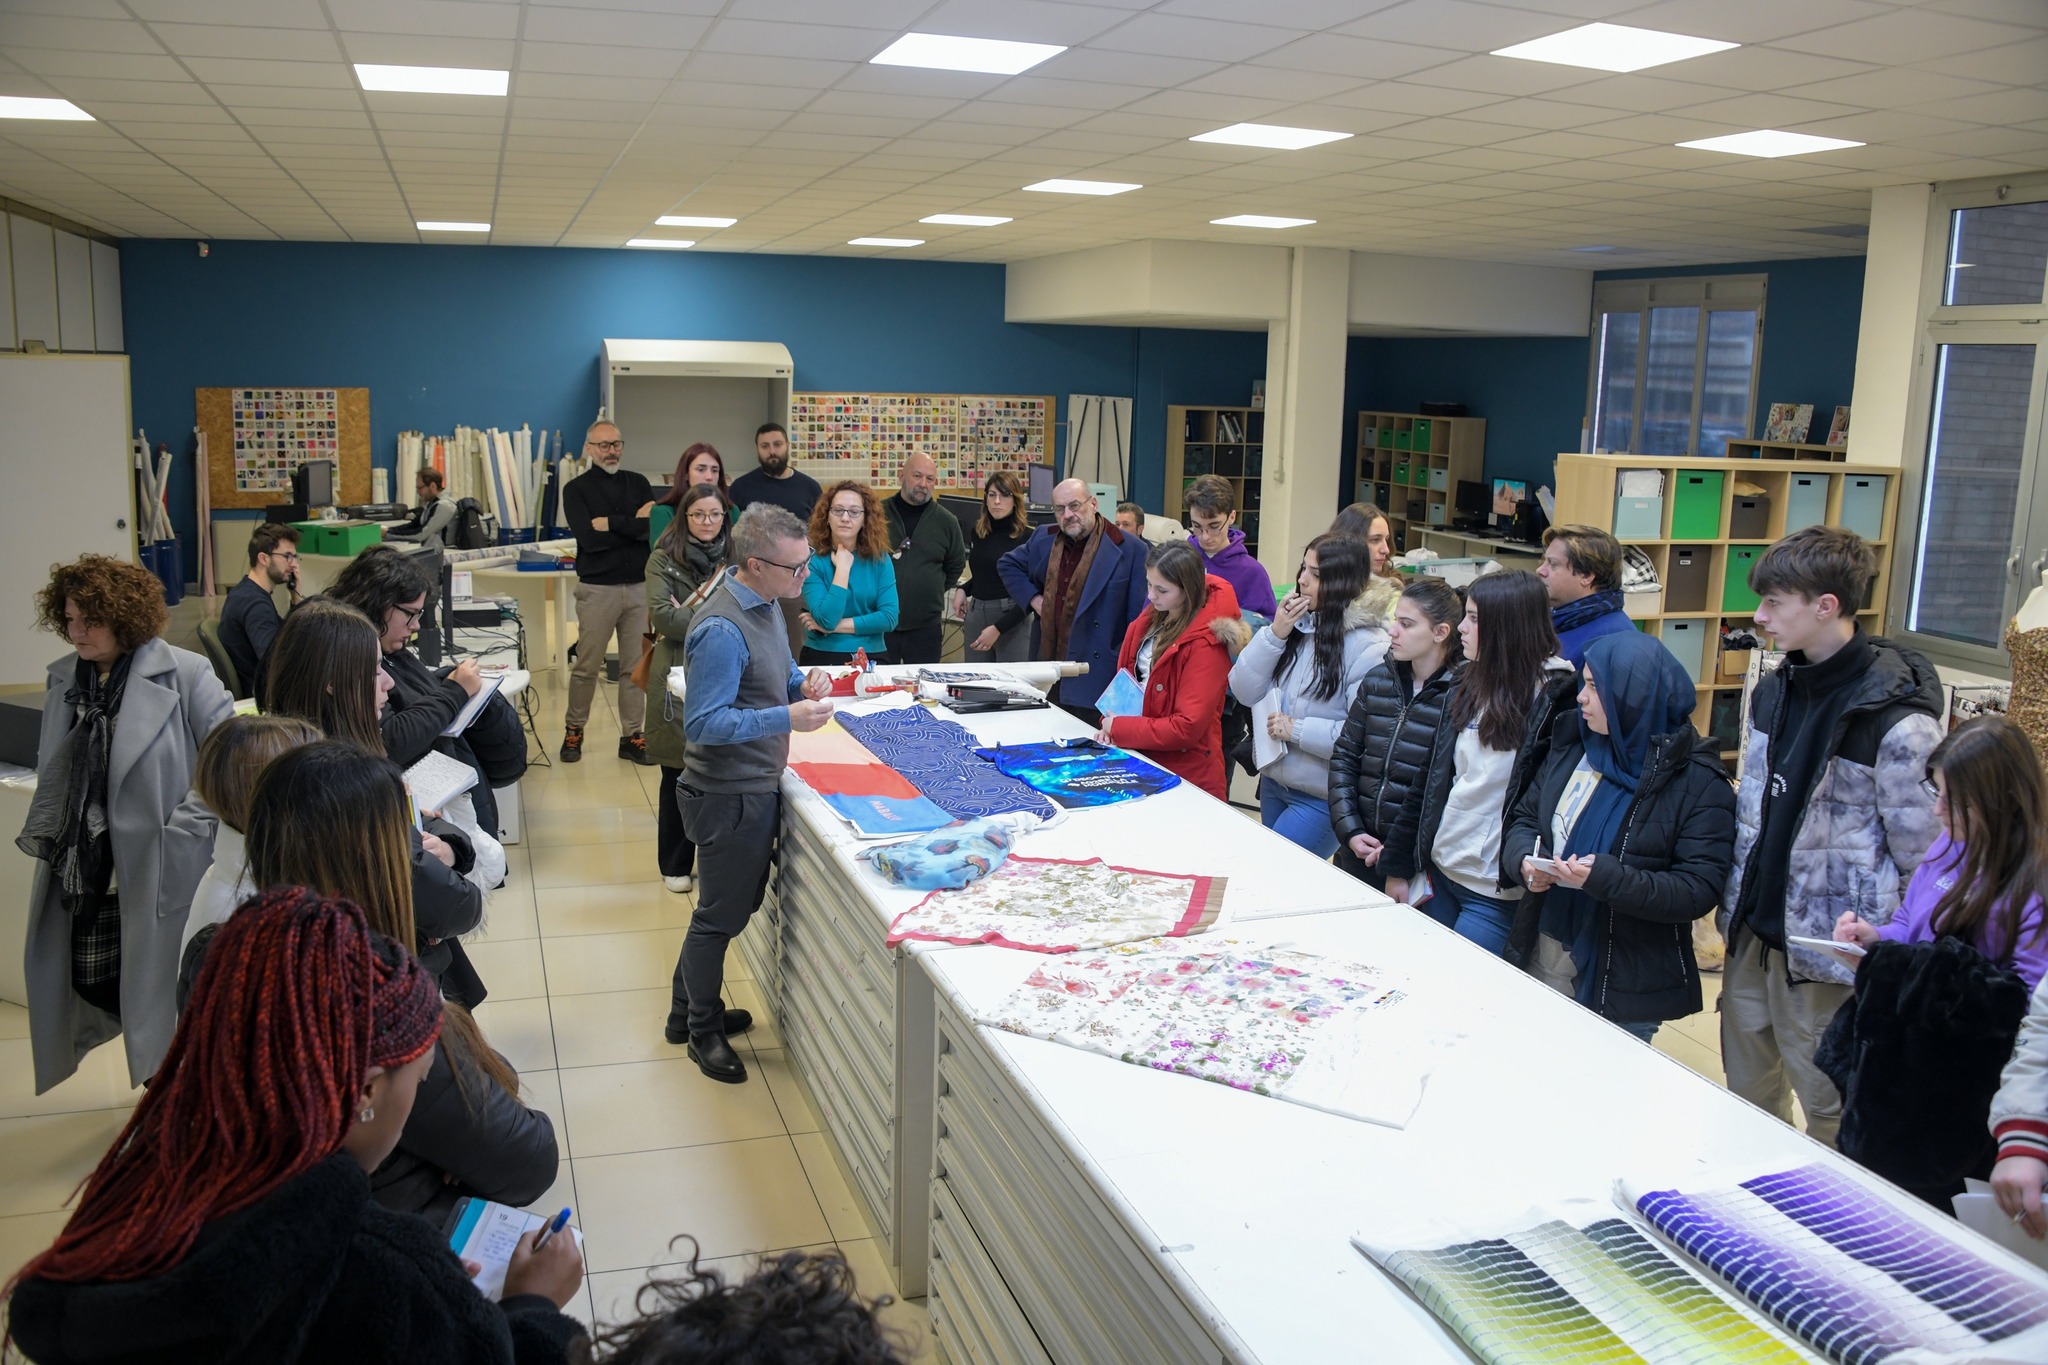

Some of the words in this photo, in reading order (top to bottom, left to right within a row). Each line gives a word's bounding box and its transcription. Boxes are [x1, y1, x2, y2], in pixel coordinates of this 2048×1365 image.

[1750, 662, 1757, 679] DA
[1073, 772, 1138, 782] DECATHLON
[499, 1213, 508, 1221] 19
